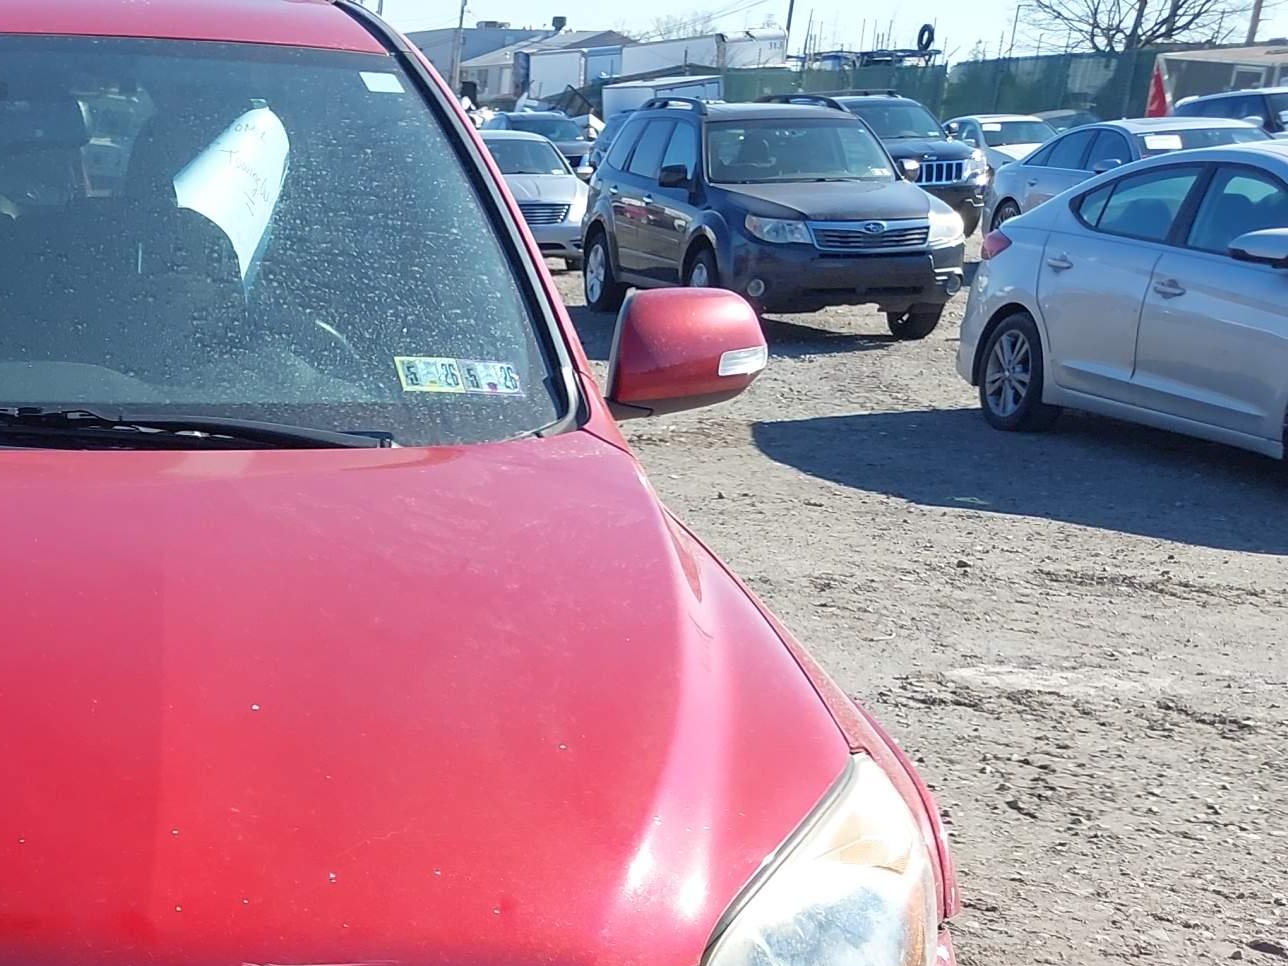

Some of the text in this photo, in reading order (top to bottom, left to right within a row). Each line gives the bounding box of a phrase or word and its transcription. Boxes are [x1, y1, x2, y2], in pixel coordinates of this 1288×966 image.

[405, 363, 460, 386] 5 26
[465, 366, 518, 390] 5 26
